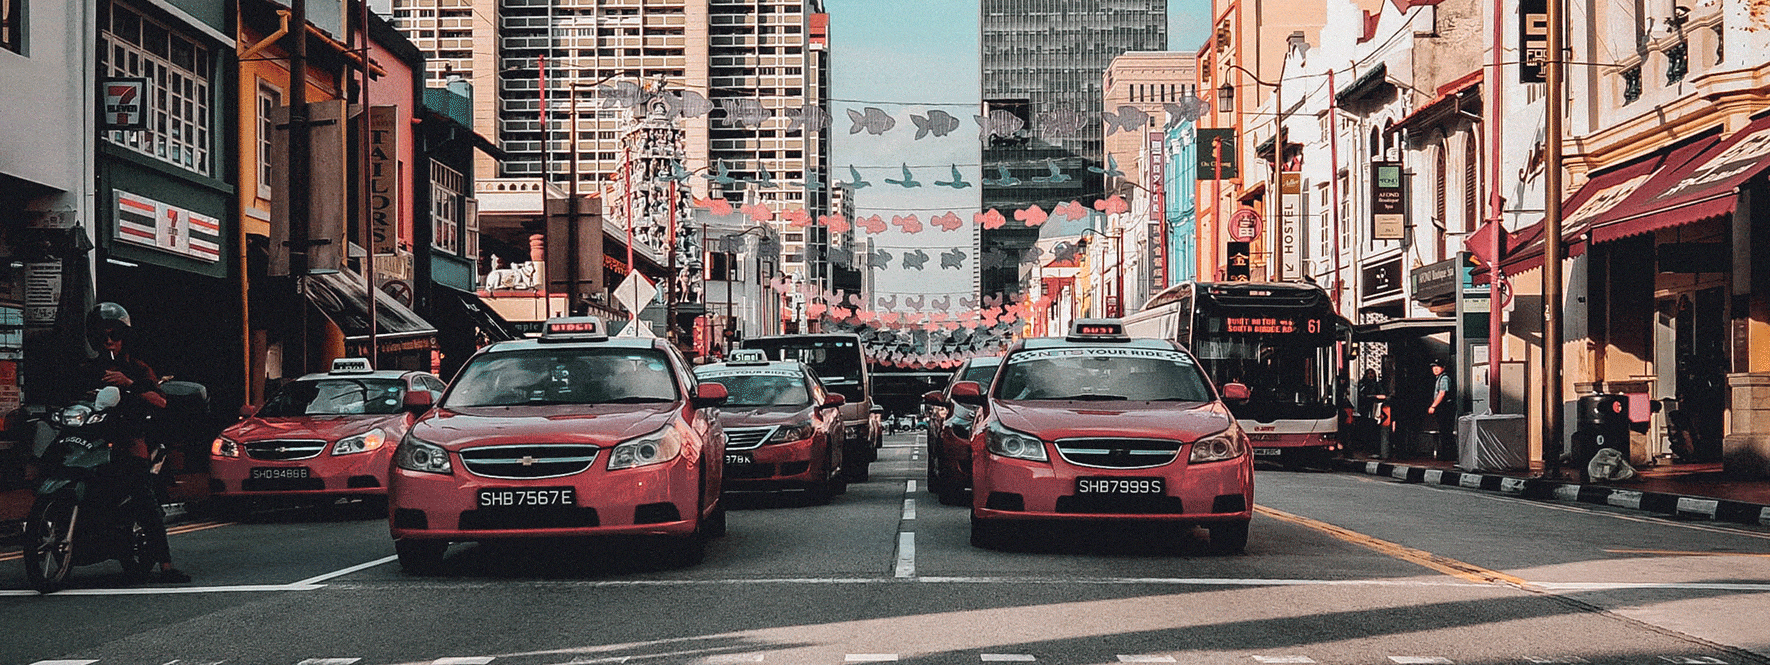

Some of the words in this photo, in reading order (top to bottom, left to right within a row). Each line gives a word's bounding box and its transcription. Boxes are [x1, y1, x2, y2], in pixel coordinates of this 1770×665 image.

[370, 129, 390, 243] TAILORS
[1284, 203, 1294, 254] HOSTEL
[1308, 319, 1321, 334] 61
[1079, 480, 1161, 494] SHB7999S
[481, 490, 573, 506] SHB7567E
